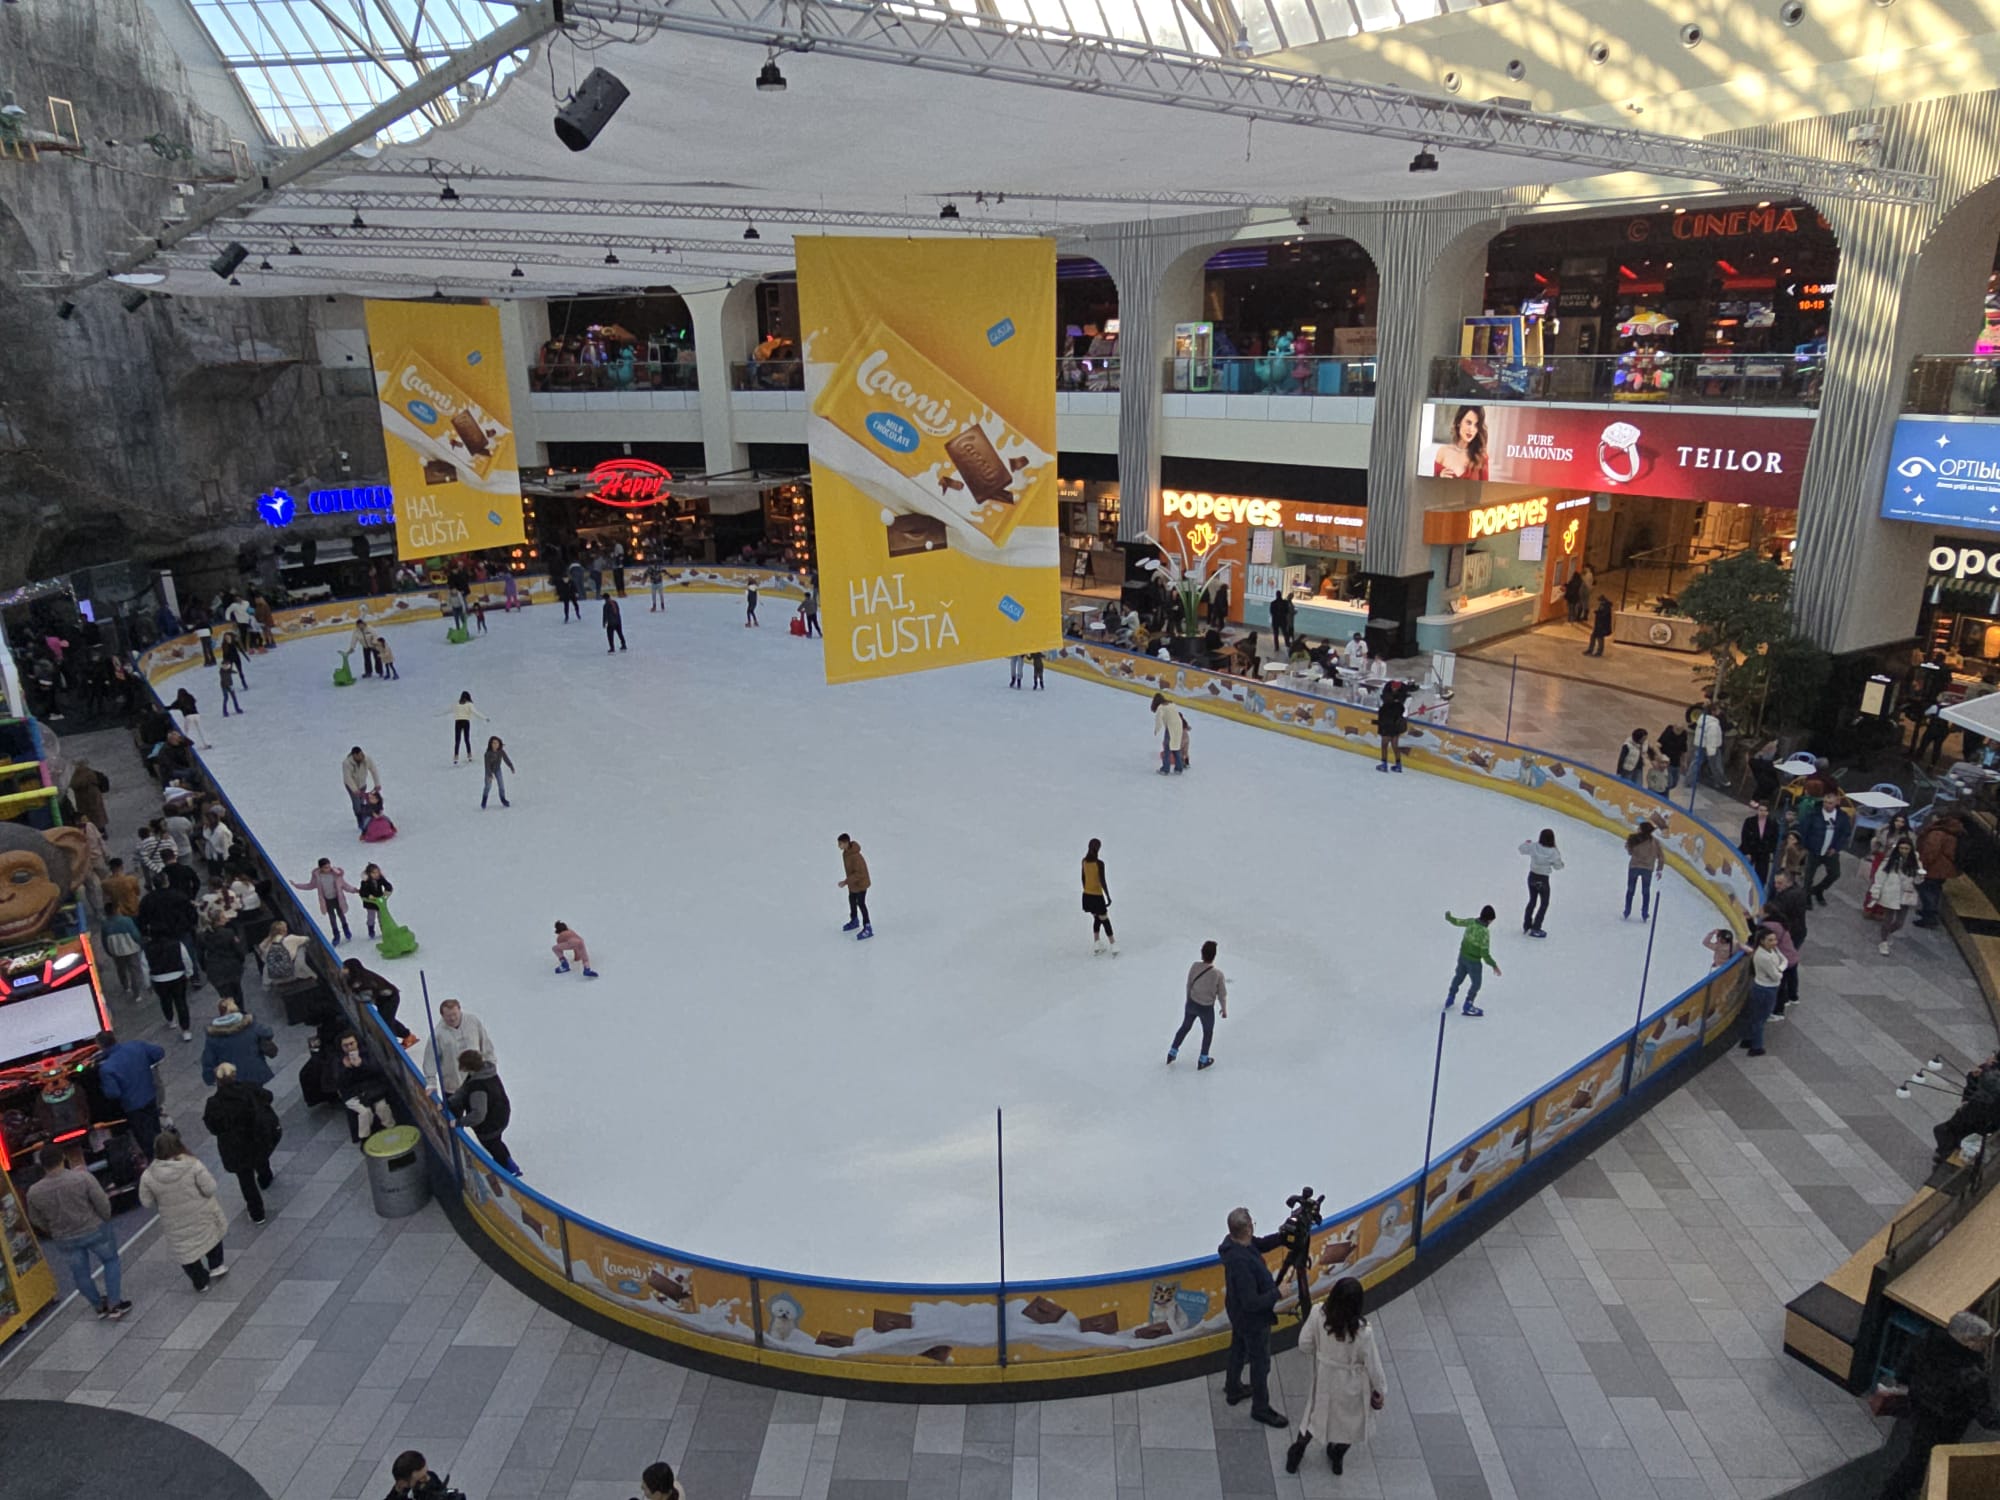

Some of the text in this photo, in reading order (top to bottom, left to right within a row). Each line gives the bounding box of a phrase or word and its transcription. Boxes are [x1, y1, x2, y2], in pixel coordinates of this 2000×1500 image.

[1672, 208, 1798, 240] CINEMA
[401, 364, 454, 411] Lacmi
[856, 350, 951, 425] Lacmi
[872, 420, 911, 448] CHOCOLATE
[885, 418, 904, 434] MILK
[1526, 433, 1554, 446] PURE
[1506, 445, 1574, 462] DIAMONDS
[1676, 446, 1783, 474] TEILOR
[594, 471, 664, 498] Happy
[405, 494, 443, 520] HAI,
[409, 512, 470, 548] GUSTĂ
[849, 574, 915, 617] HAI,
[851, 600, 960, 662] GUSTĂ
[603, 1256, 642, 1279] Lacmi
